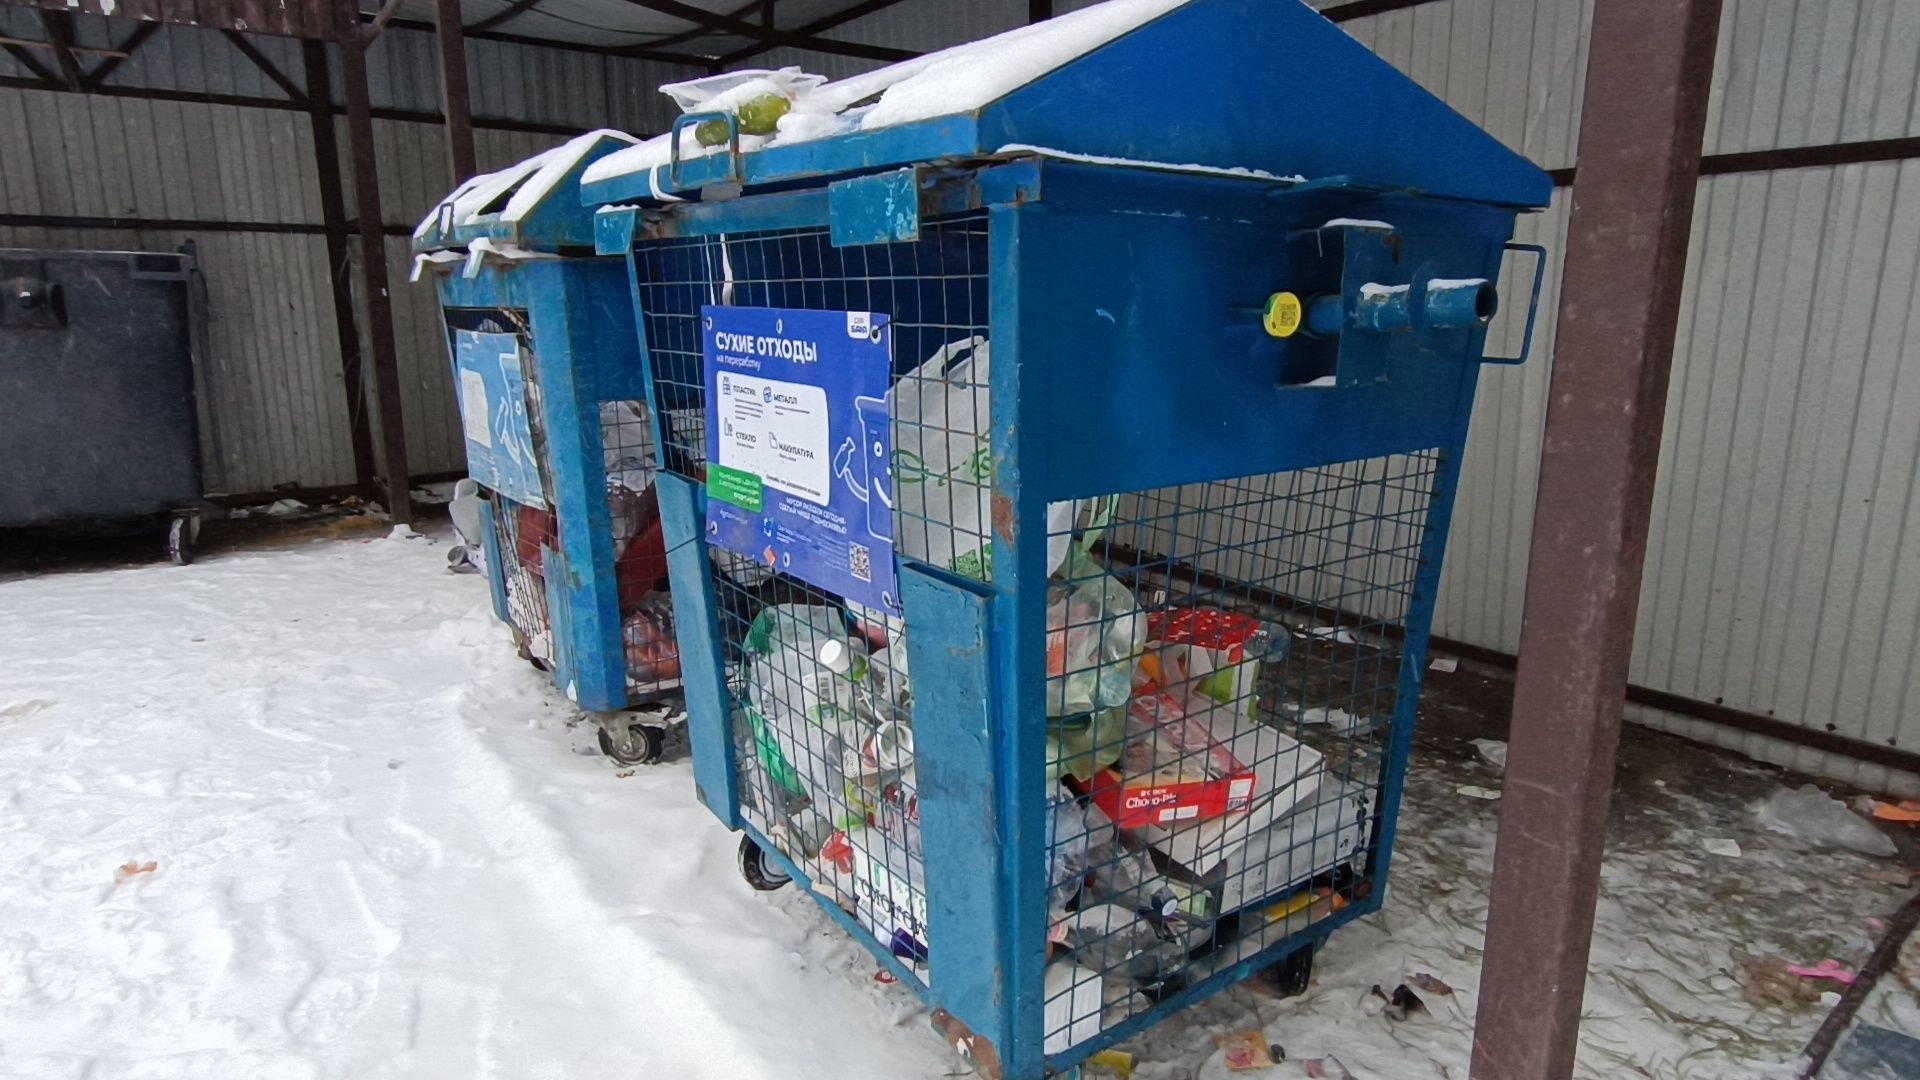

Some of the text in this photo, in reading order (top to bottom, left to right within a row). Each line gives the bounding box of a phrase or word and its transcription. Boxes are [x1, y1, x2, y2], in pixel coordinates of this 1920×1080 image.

[716, 332, 817, 364] СУХИЕ ОТХОДЫ
[716, 354, 761, 371] на переработку
[733, 385, 756, 396] ПЛАСТИК
[774, 394, 797, 404] МЕТАЛЛ
[736, 432, 756, 442] СТЕКЛО
[779, 443, 814, 459] МАКУЛАТУРА
